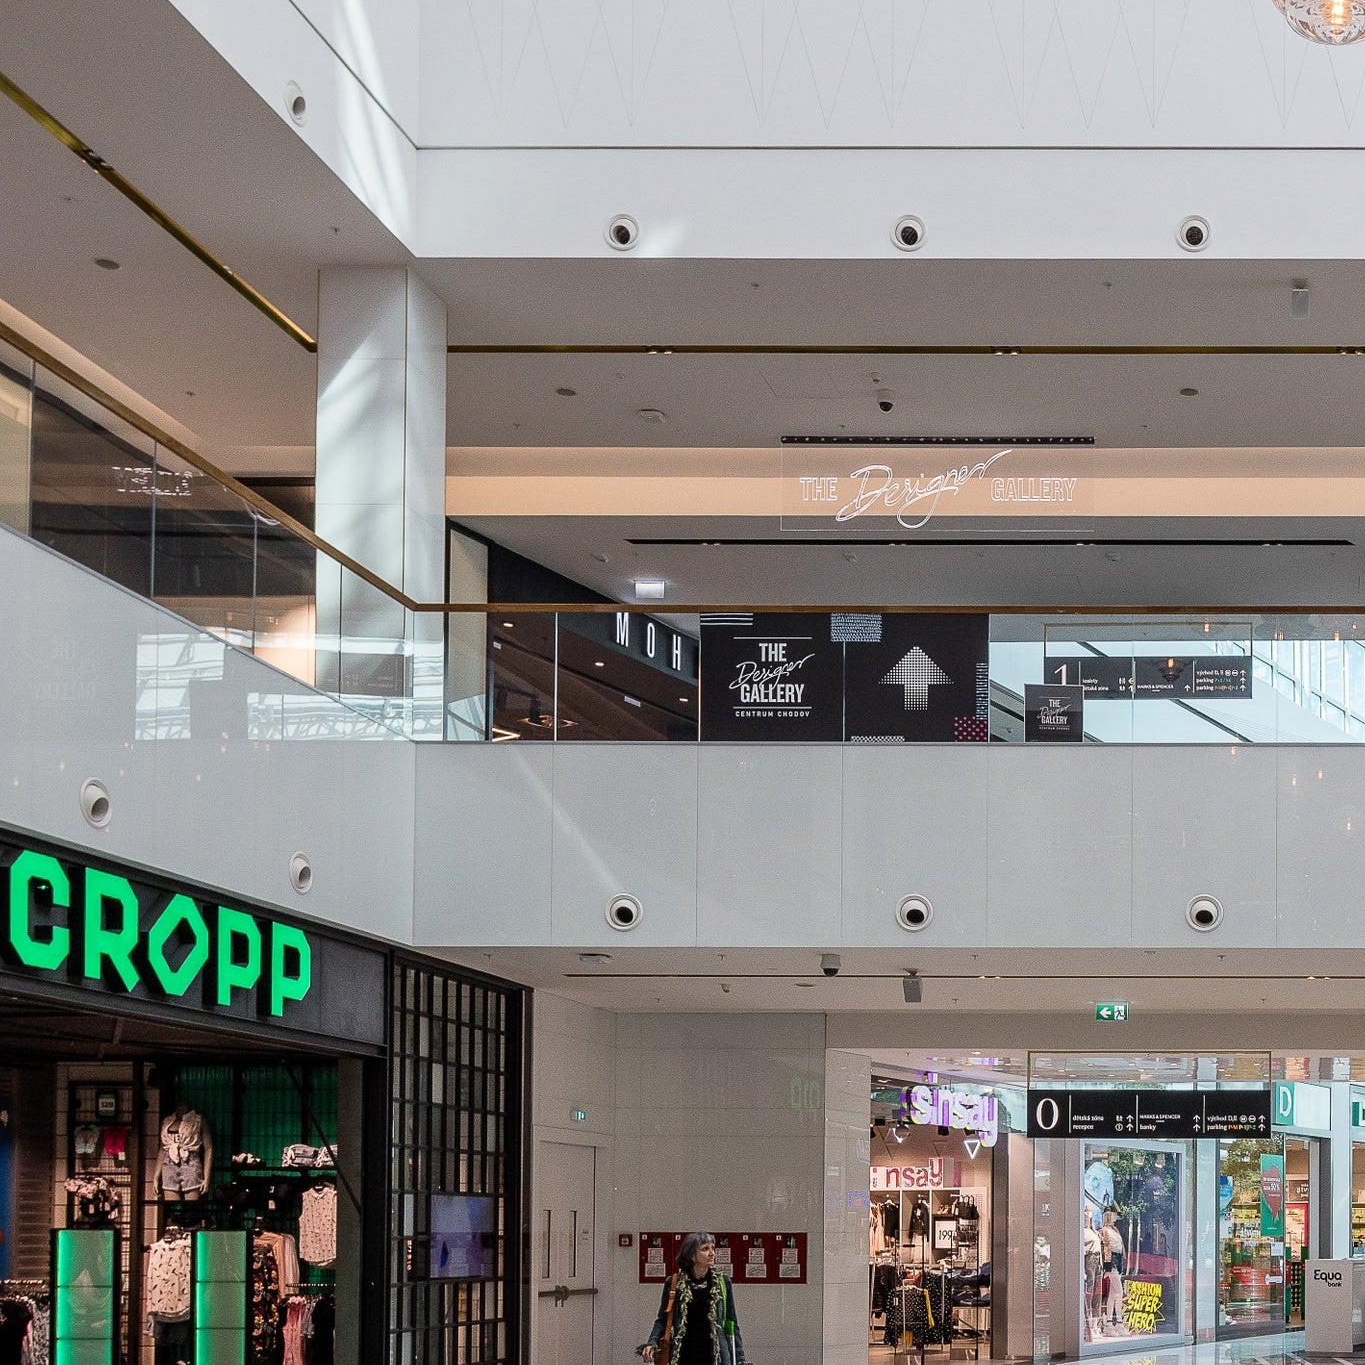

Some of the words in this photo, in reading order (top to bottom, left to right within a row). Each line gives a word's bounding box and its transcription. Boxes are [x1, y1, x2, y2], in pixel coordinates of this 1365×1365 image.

[799, 477, 838, 502] THE
[835, 449, 1013, 529] Designer
[990, 477, 1078, 503] GALLERY
[758, 642, 788, 662] THE
[728, 653, 816, 690] Designer
[1055, 664, 1067, 685] 1
[740, 683, 805, 703] GALLERY
[1049, 699, 1061, 707] THE
[1041, 715, 1069, 724] GALLERY
[9, 849, 312, 1017] CROPP
[1279, 1086, 1293, 1117] D
[908, 1085, 999, 1147] sinsay
[1036, 1098, 1059, 1130] 0
[1313, 1269, 1342, 1283] Equa
[1124, 1280, 1163, 1297] FASHION
[1127, 1295, 1160, 1313] SUPER
[1128, 1311, 1155, 1332] HERO
